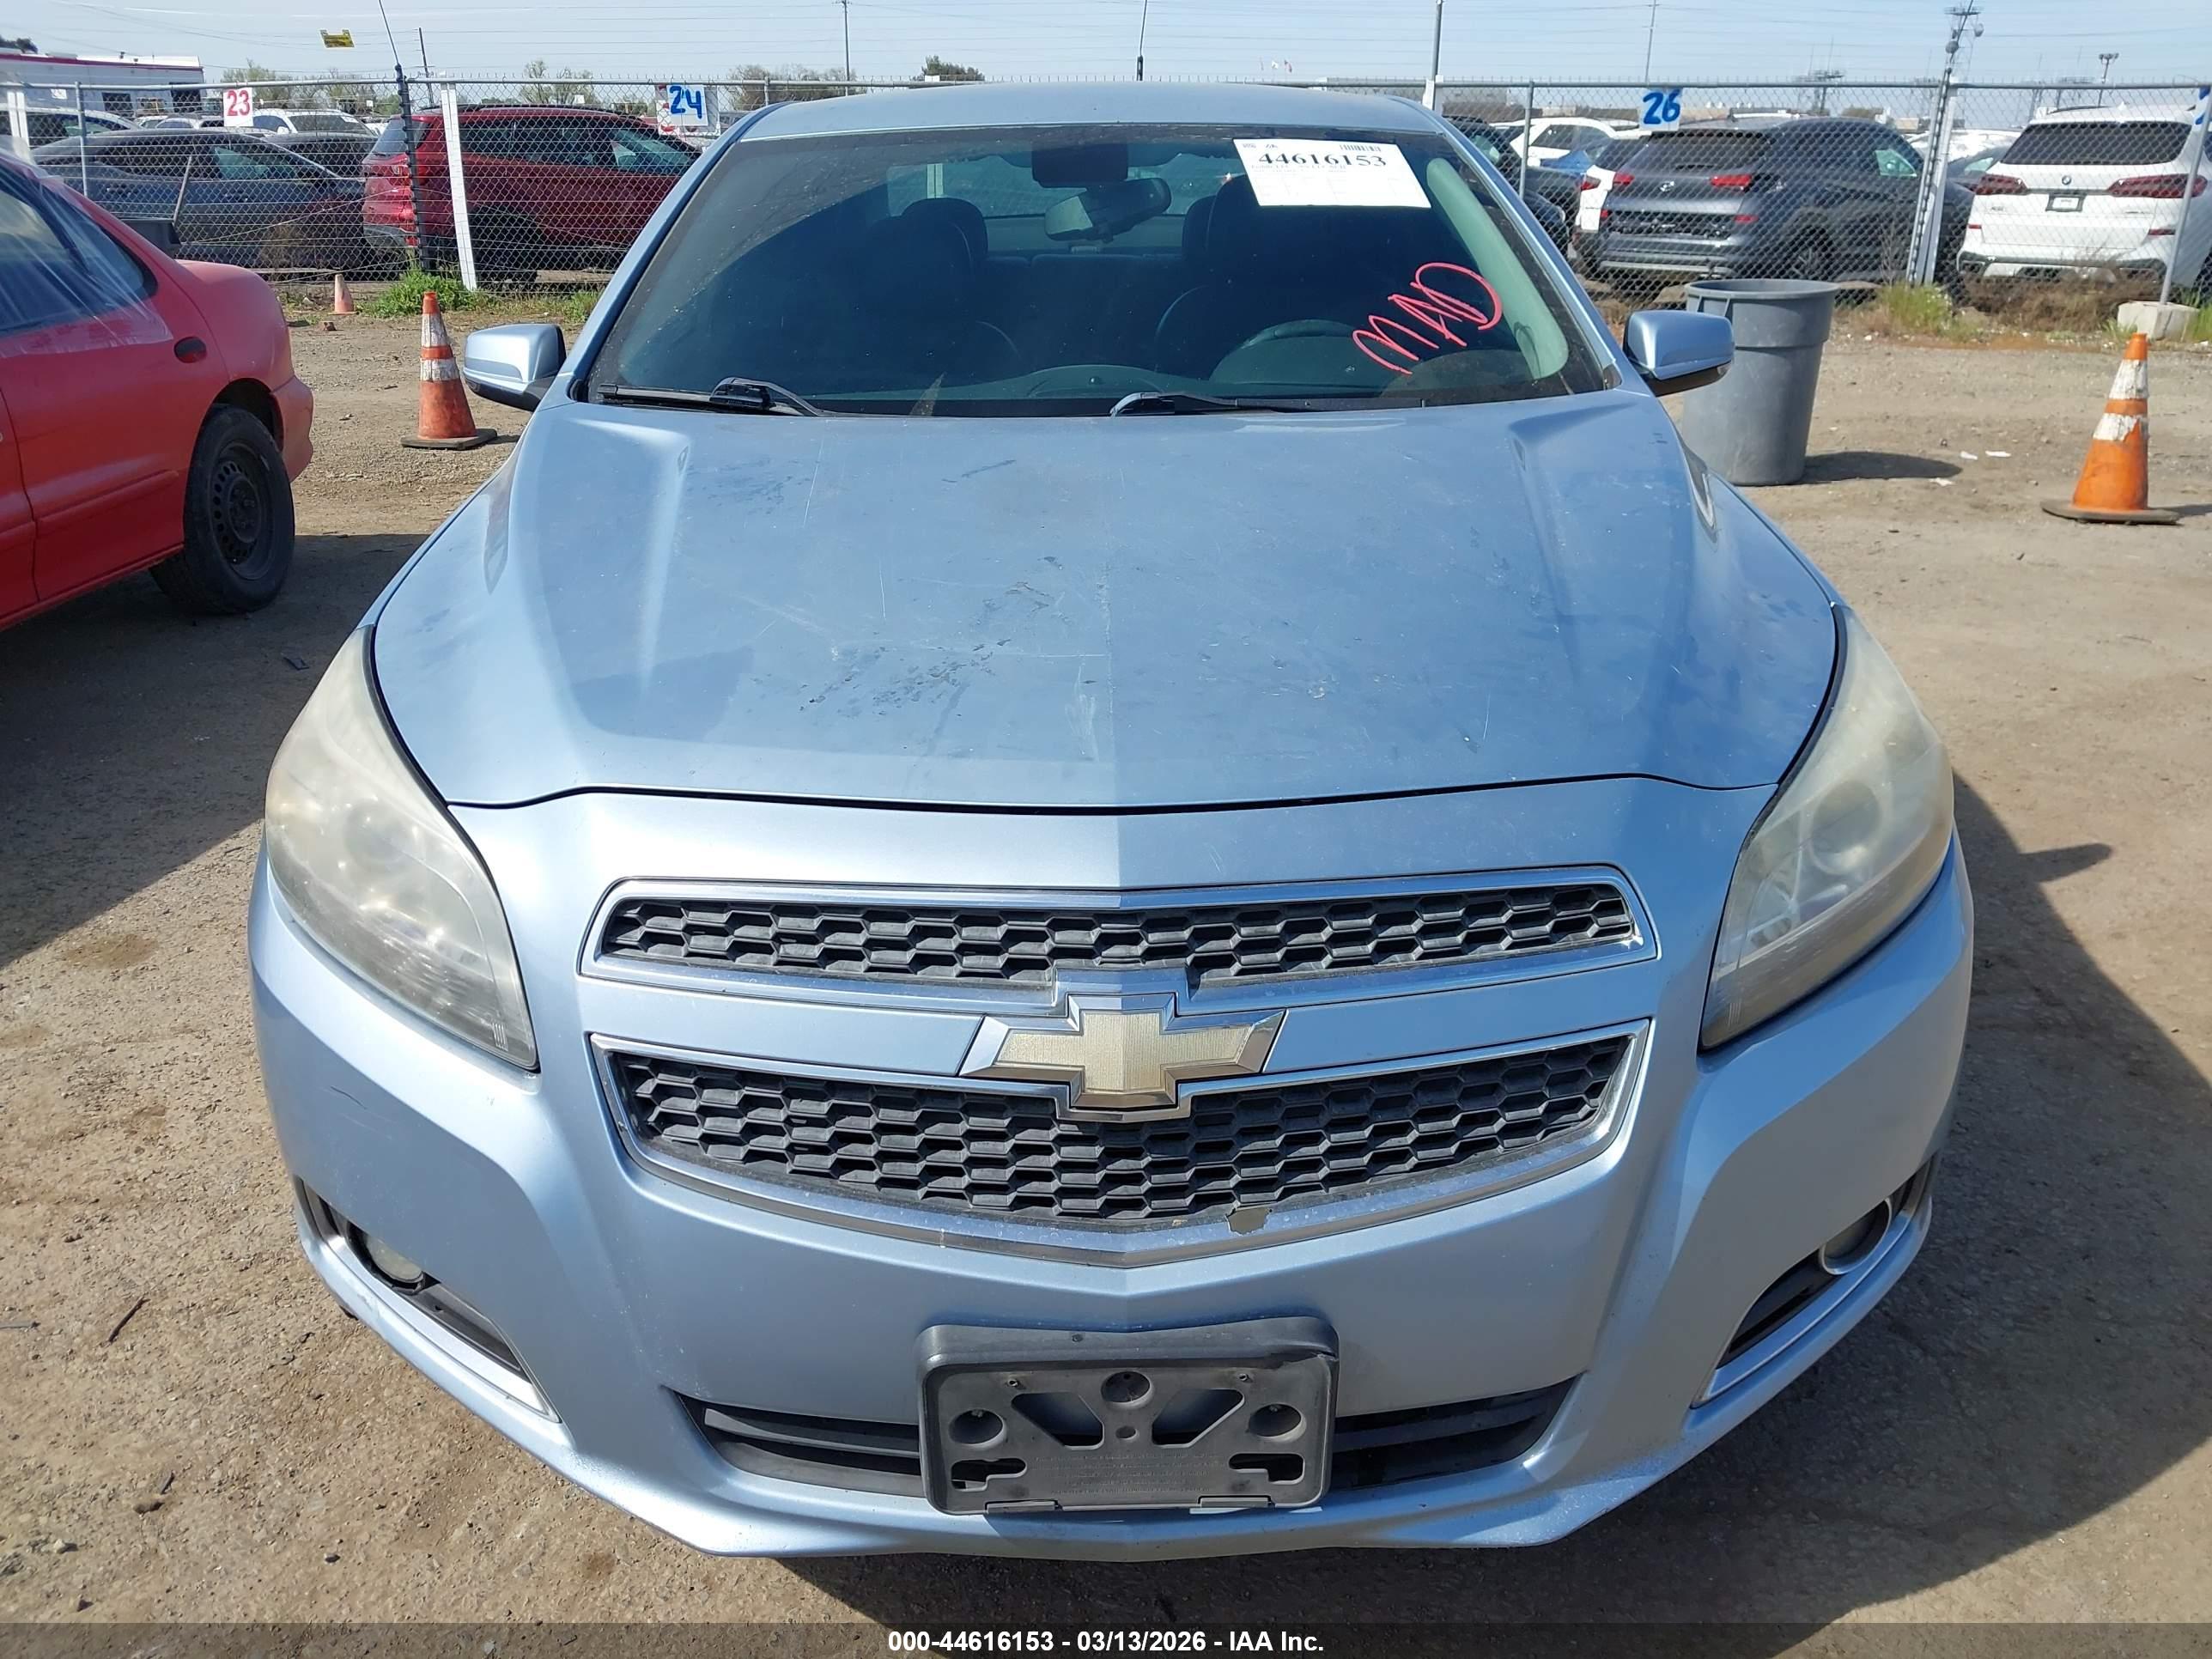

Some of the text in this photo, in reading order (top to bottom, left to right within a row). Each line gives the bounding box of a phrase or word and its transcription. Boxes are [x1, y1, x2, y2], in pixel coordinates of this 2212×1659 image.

[227, 89, 251, 117] 23
[670, 85, 702, 119] 24
[1643, 88, 1680, 125] 26
[1258, 153, 1387, 167] 44616153
